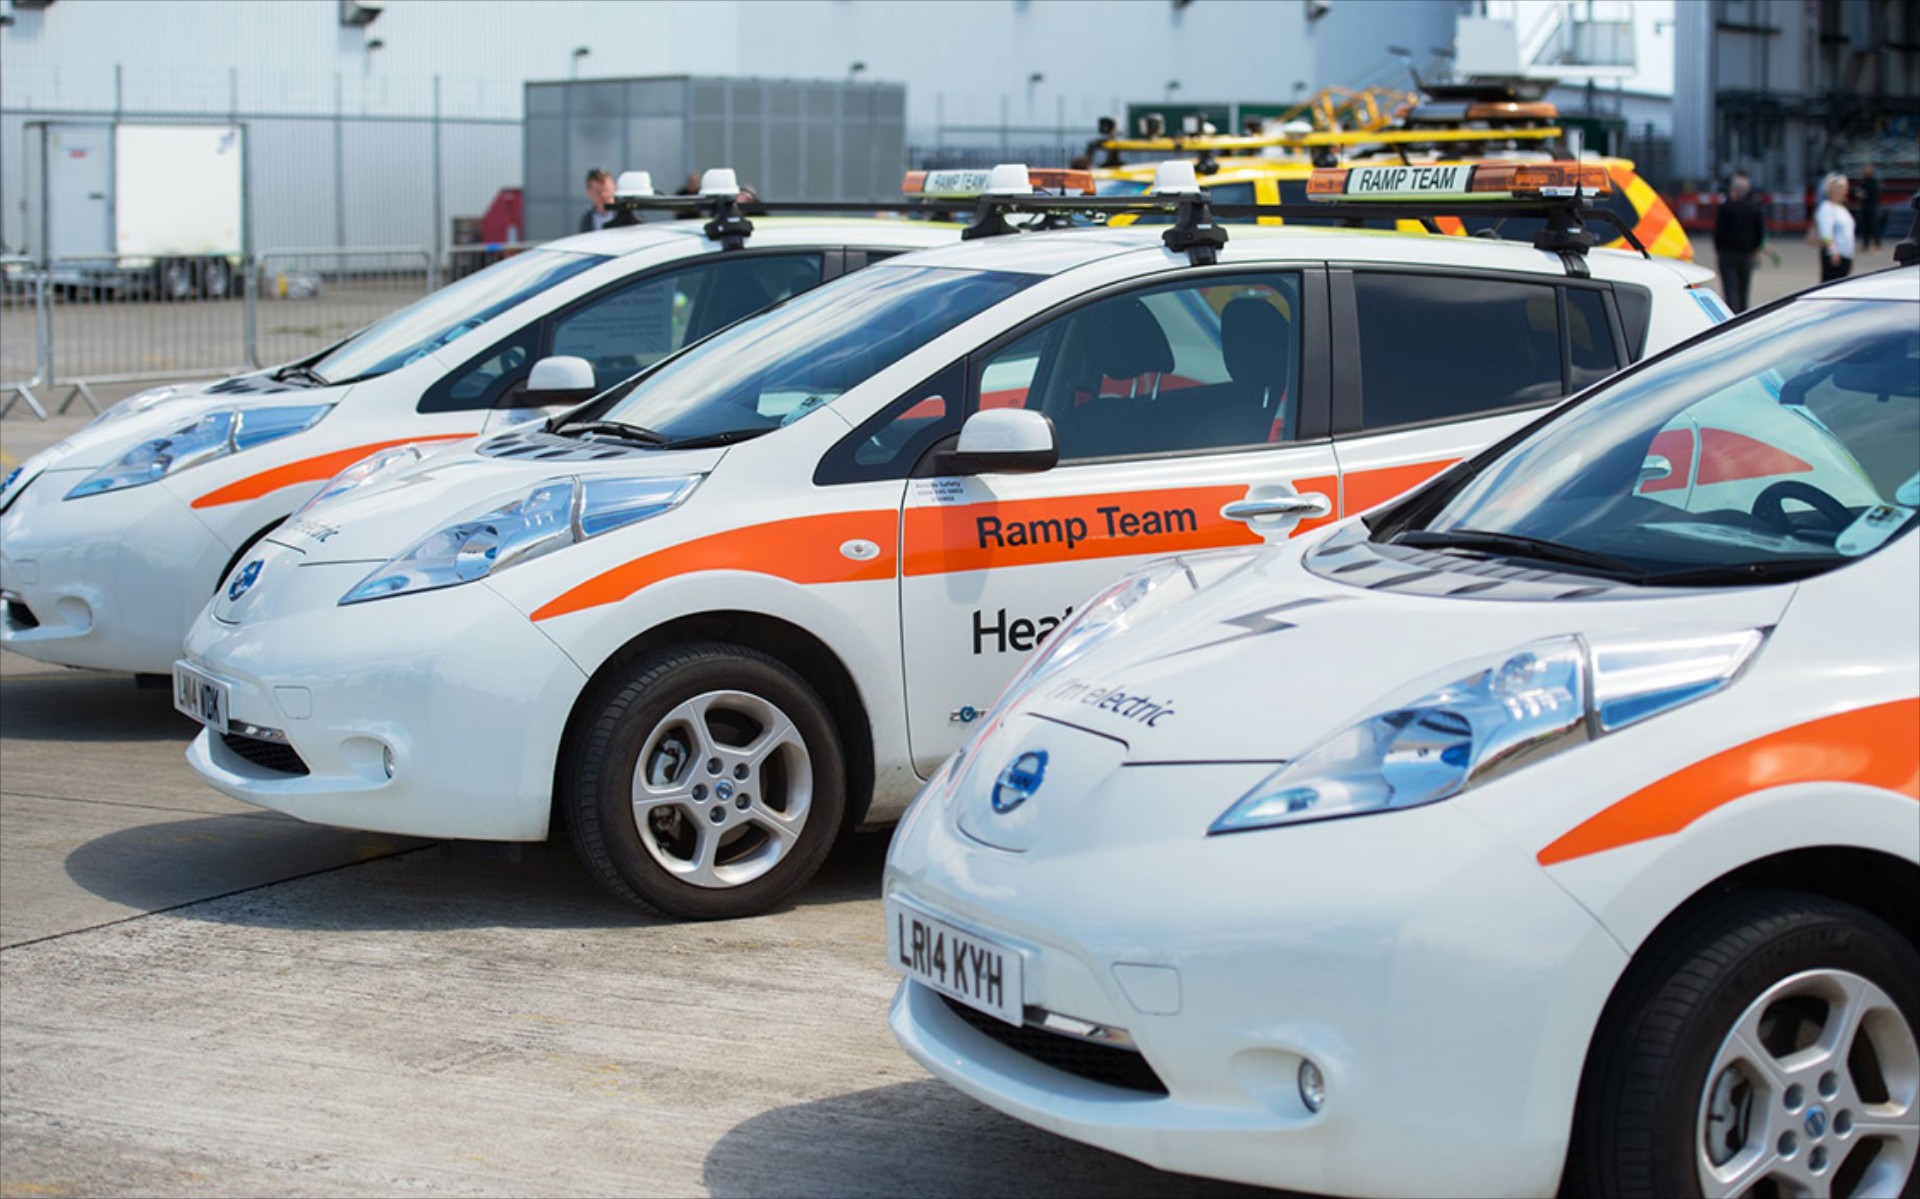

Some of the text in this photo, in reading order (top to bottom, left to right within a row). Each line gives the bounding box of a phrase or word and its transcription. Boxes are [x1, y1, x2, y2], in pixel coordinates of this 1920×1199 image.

[934, 173, 961, 190] RAMP
[1359, 167, 1458, 191] RAMP TEAM
[975, 506, 1198, 549] Ramp Team
[973, 606, 1072, 655] Hea
[1081, 684, 1175, 727] electric
[898, 912, 1003, 1009] LR14 KYH
